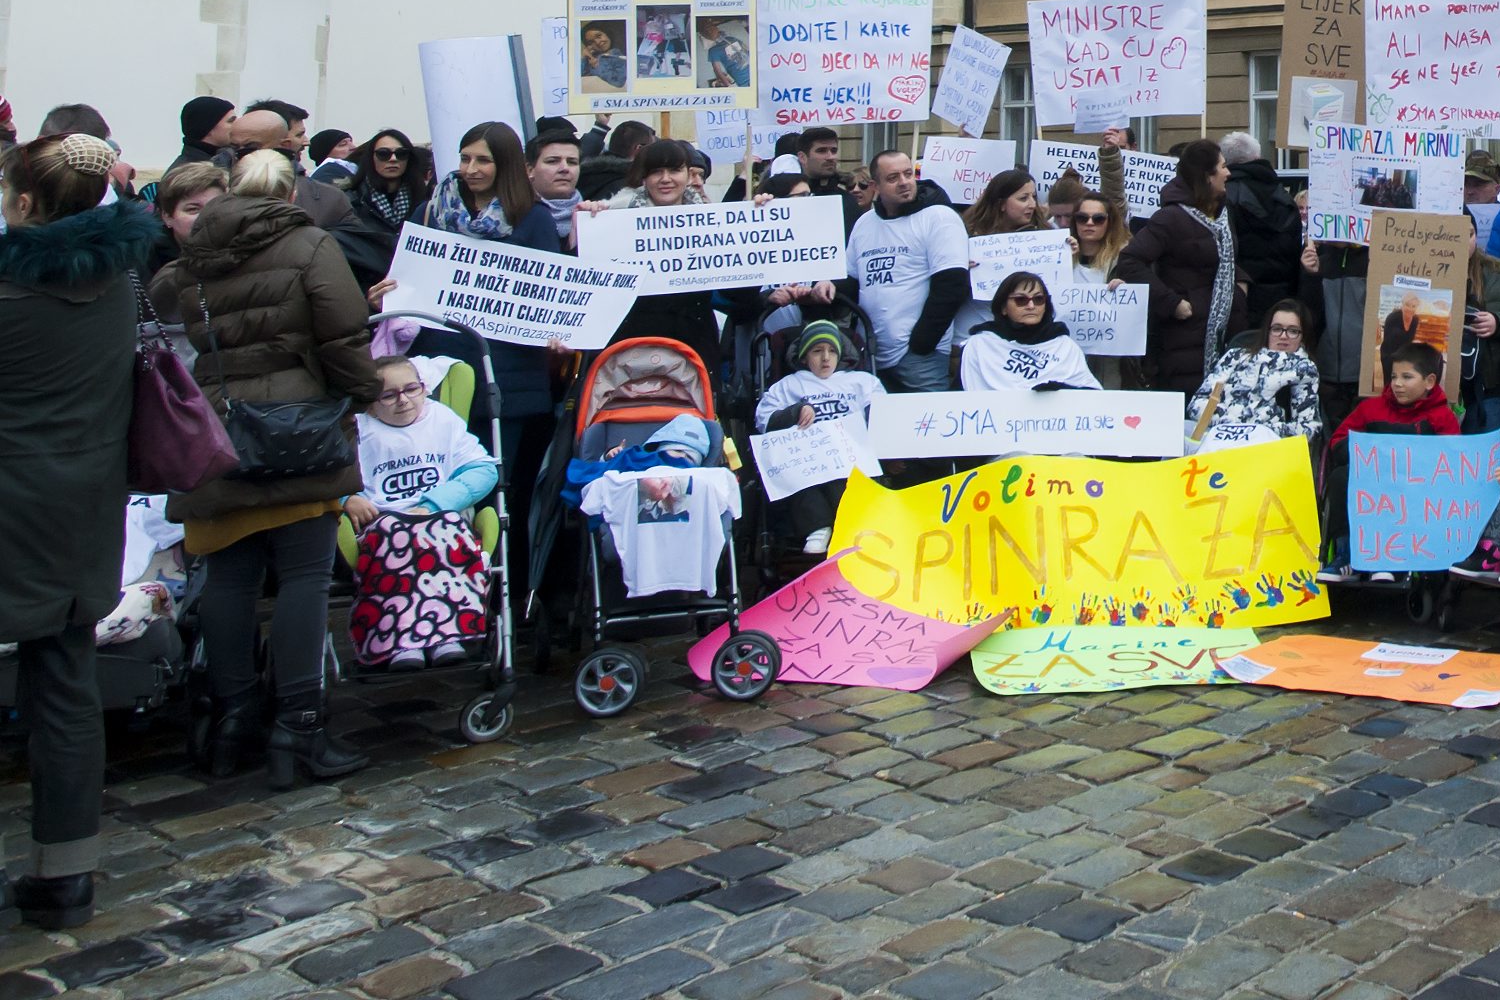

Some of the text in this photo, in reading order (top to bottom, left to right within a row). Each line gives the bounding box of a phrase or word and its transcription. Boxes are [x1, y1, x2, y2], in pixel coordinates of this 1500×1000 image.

[768, 20, 912, 44] DOĐITE I KAŽITE
[1042, 4, 1164, 37] MINISTRE
[1312, 16, 1342, 38] ZA
[1065, 40, 1110, 65] KAD
[1304, 42, 1352, 68] SVE
[1387, 31, 1421, 58] ALI
[1443, 28, 1492, 51] NAŠA
[770, 52, 930, 73] OVOJ DJECI DA IM NE
[1053, 65, 1159, 90] USTAT IZ
[1388, 69, 1411, 90] SE
[1417, 63, 1439, 81] NE
[604, 97, 630, 108] SMA
[632, 96, 690, 108] SPINRAZA
[691, 95, 707, 106] ZA
[709, 94, 732, 105] SVE
[771, 86, 812, 103] DATE
[775, 106, 903, 125] SRAM VAS BILO
[930, 140, 977, 165] ŽIVOT
[1047, 147, 1096, 160] HELENA
[1315, 125, 1460, 158] SPINRAZA MARINU
[953, 168, 993, 184] NEMA
[636, 207, 791, 231] MINISTRE, DA LI SU
[1313, 213, 1371, 244] SPINRAZ
[635, 227, 795, 253] BLINDIRANA VOZILA
[405, 235, 638, 290] HELENA ŽELI SPINRAZU ZA SNAŽNIJE RUKE,
[660, 257, 683, 273] OD
[687, 253, 743, 271] ŽIVOTA
[746, 249, 779, 265] OVE
[781, 245, 838, 263] DJECE?
[1429, 248, 1456, 259] SADA
[452, 269, 593, 307] DA MOŽE UBRATI CVIJET
[669, 272, 764, 287] #SMAspinrazazasve
[866, 271, 894, 287] SMA
[437, 290, 587, 327] I NASLIKATI CIJELI SVIJET.
[1058, 288, 1138, 306] SPINRAZA
[1070, 309, 1118, 322] JEDINI
[1076, 328, 1115, 342] SPAS
[914, 408, 1115, 442] #SMA spinraza za sve
[384, 470, 439, 493] cure
[942, 458, 1228, 523] Volimo te
[1356, 489, 1481, 525] DAJ NAM
[851, 488, 1320, 602] SPINRAZA
[822, 586, 926, 636] #SMA
[1024, 630, 1197, 654] Marine
[983, 653, 1096, 678] ZA
